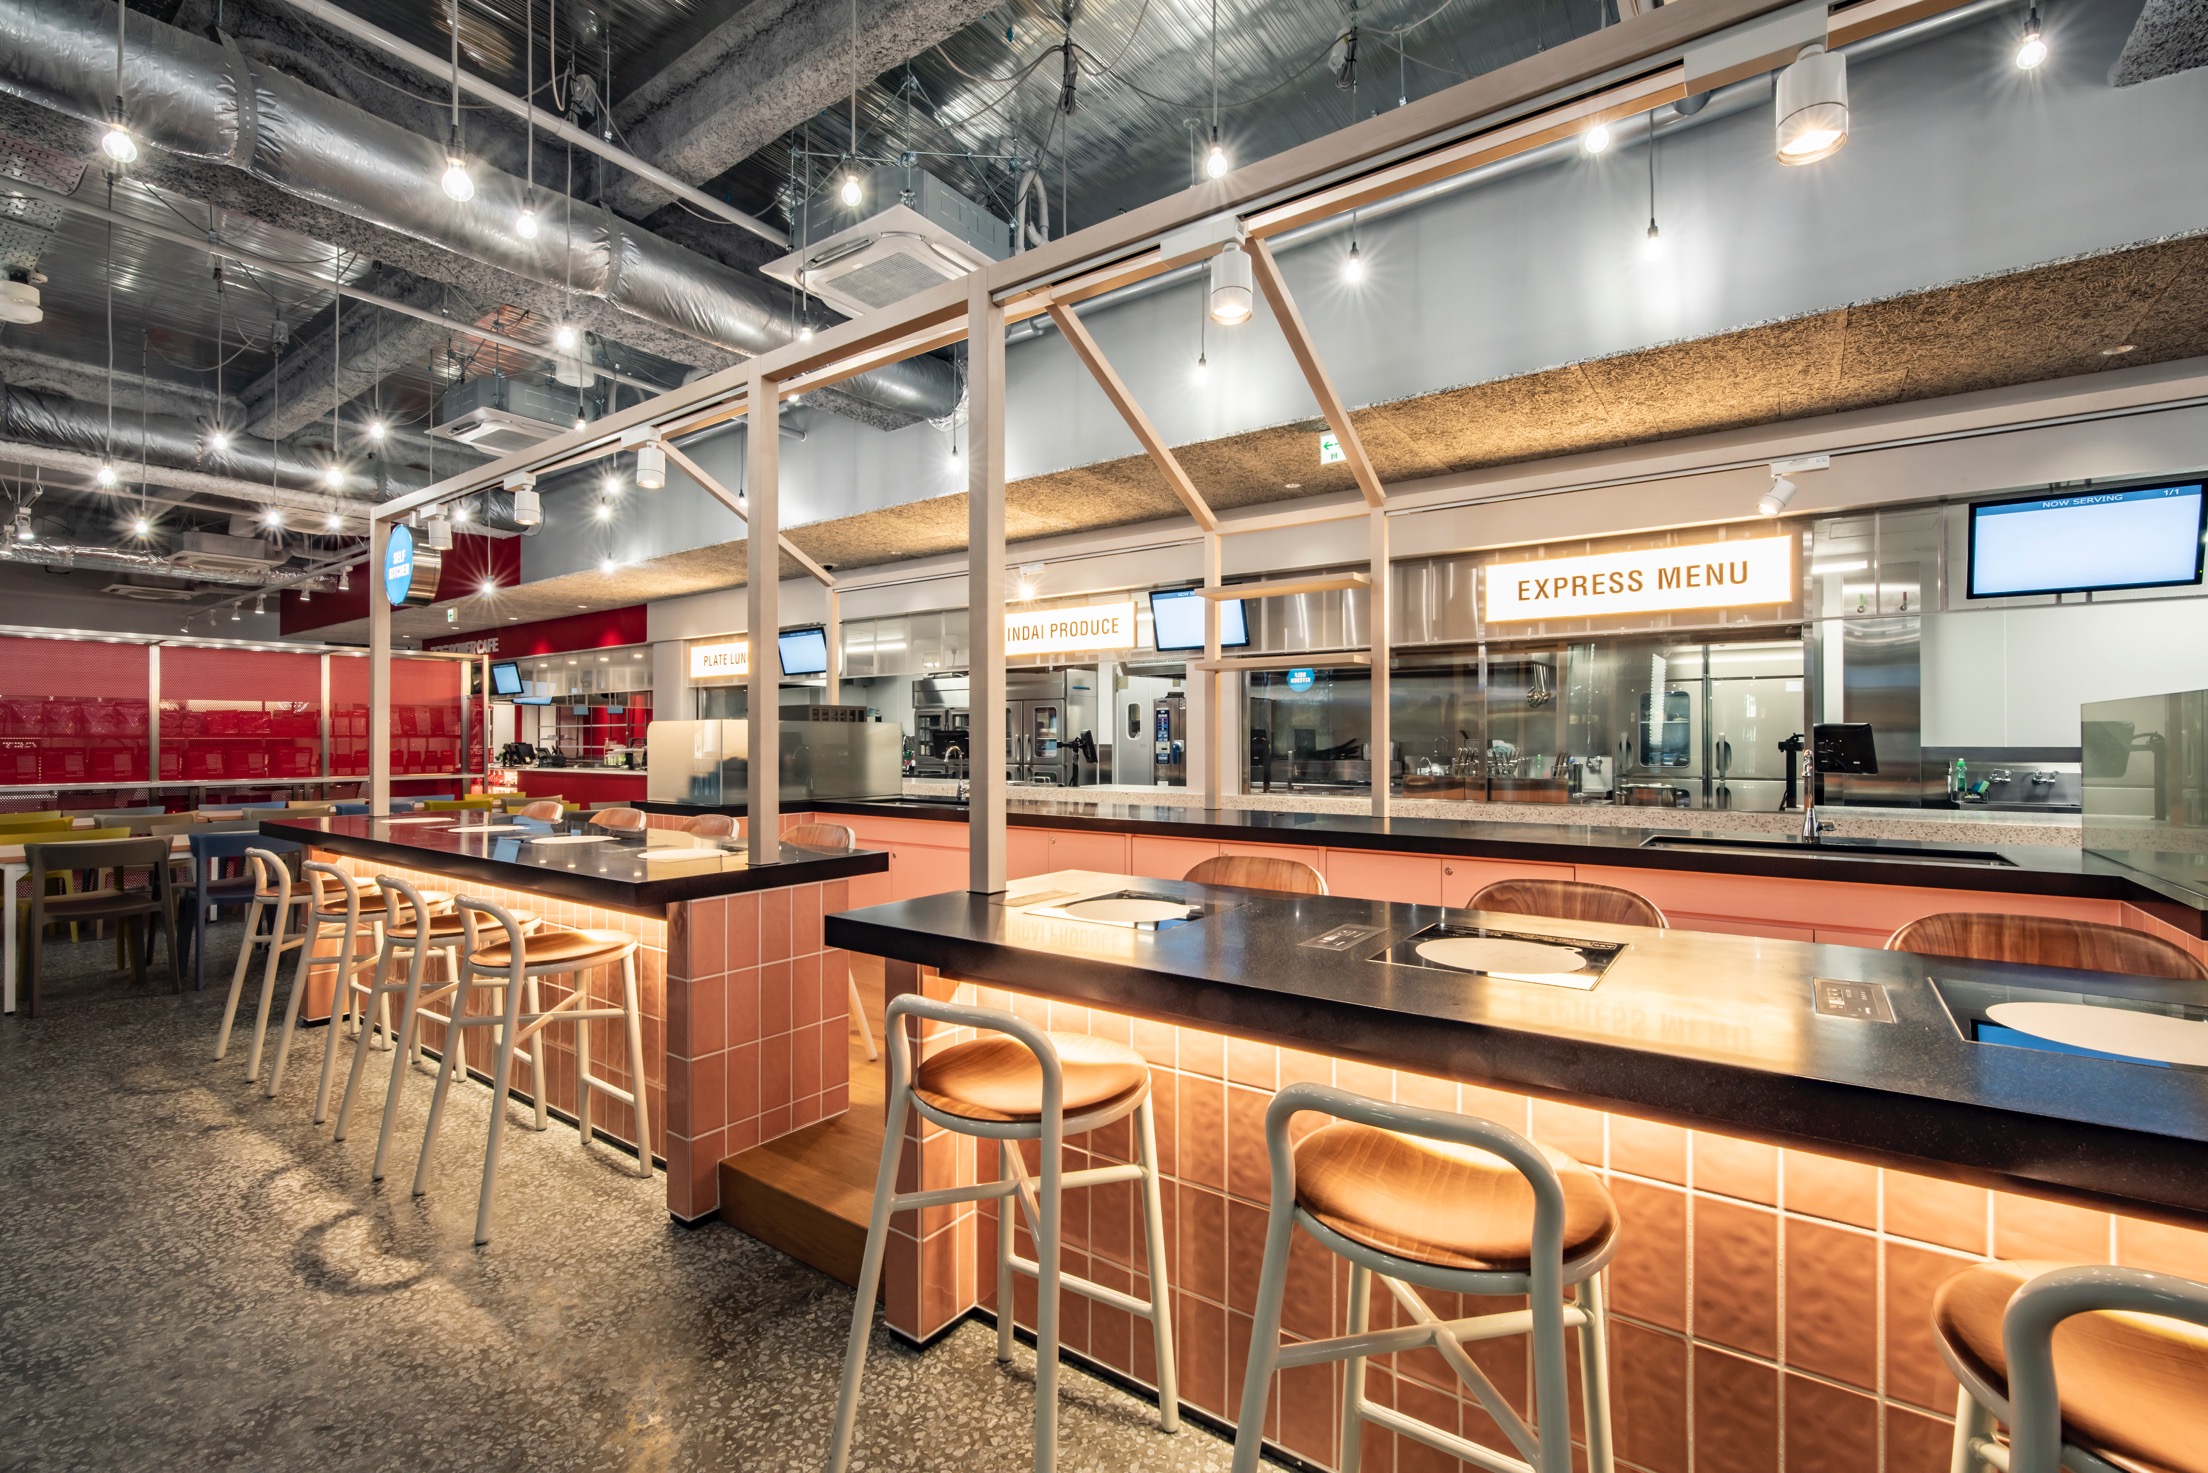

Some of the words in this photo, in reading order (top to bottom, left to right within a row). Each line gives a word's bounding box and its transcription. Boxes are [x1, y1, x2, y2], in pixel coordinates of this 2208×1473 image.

[2163, 488, 2180, 496] 1/1
[2042, 500, 2069, 508] NOW
[2072, 494, 2123, 505] SERVING
[392, 549, 406, 565] SELF
[1517, 569, 1644, 601] EXPRESS
[1657, 560, 1749, 590] MENU
[1050, 617, 1119, 639] PRODUCE
[476, 637, 500, 655] CAFE
[703, 653, 727, 667] PLATE
